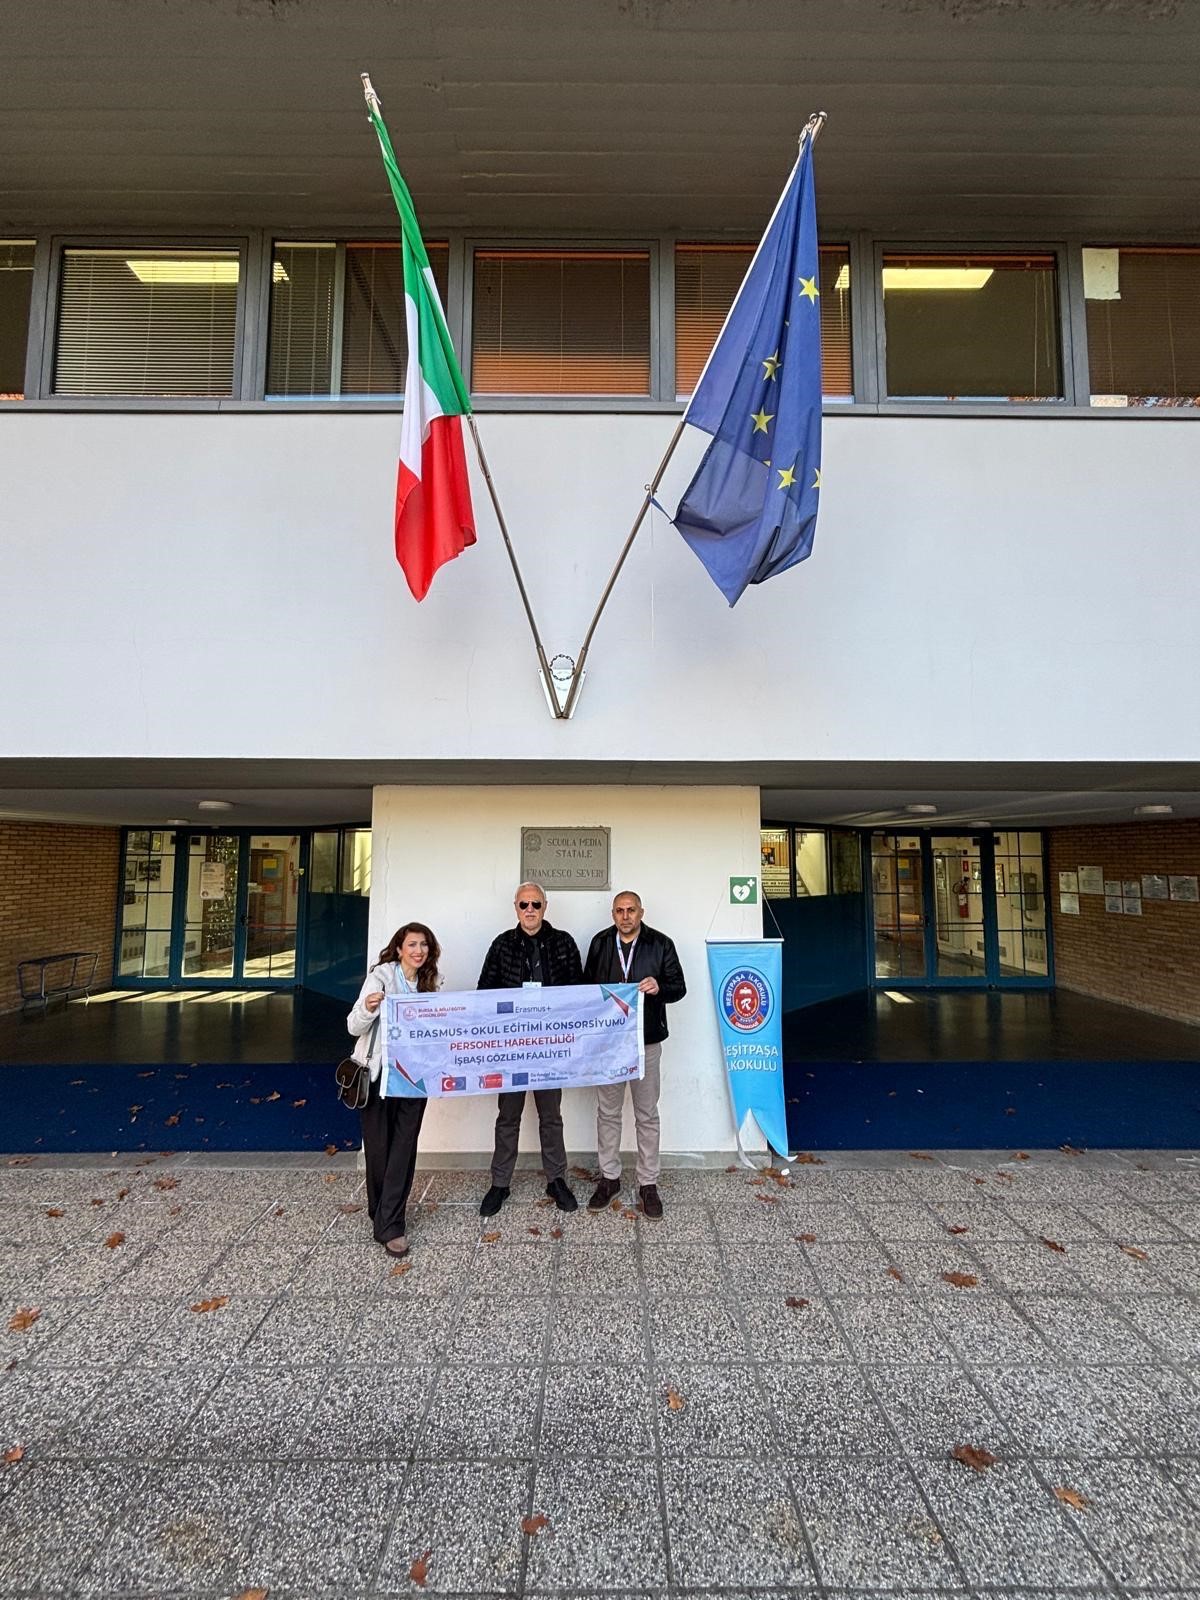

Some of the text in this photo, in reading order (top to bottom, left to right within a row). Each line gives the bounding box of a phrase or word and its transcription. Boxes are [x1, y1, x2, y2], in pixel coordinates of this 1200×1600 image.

[546, 838, 602, 847] SCUOLA MEDIA
[555, 849, 593, 858] STATALE
[526, 868, 605, 878] FRANCESCO SEVERI
[515, 1005, 552, 1013] Erasmus+
[410, 1018, 625, 1038] ERASMUS+ OKUL EĞİTİMİ KONSORSİYUMU
[450, 1033, 575, 1051] PERSONEL HAREKETLİLİĞİ
[454, 1047, 572, 1066] İŞBAŞI GÖZLEM FAALİYETİ
[723, 1042, 779, 1058] EŞİTPAŞA
[726, 1059, 778, 1072] LKOKULU
